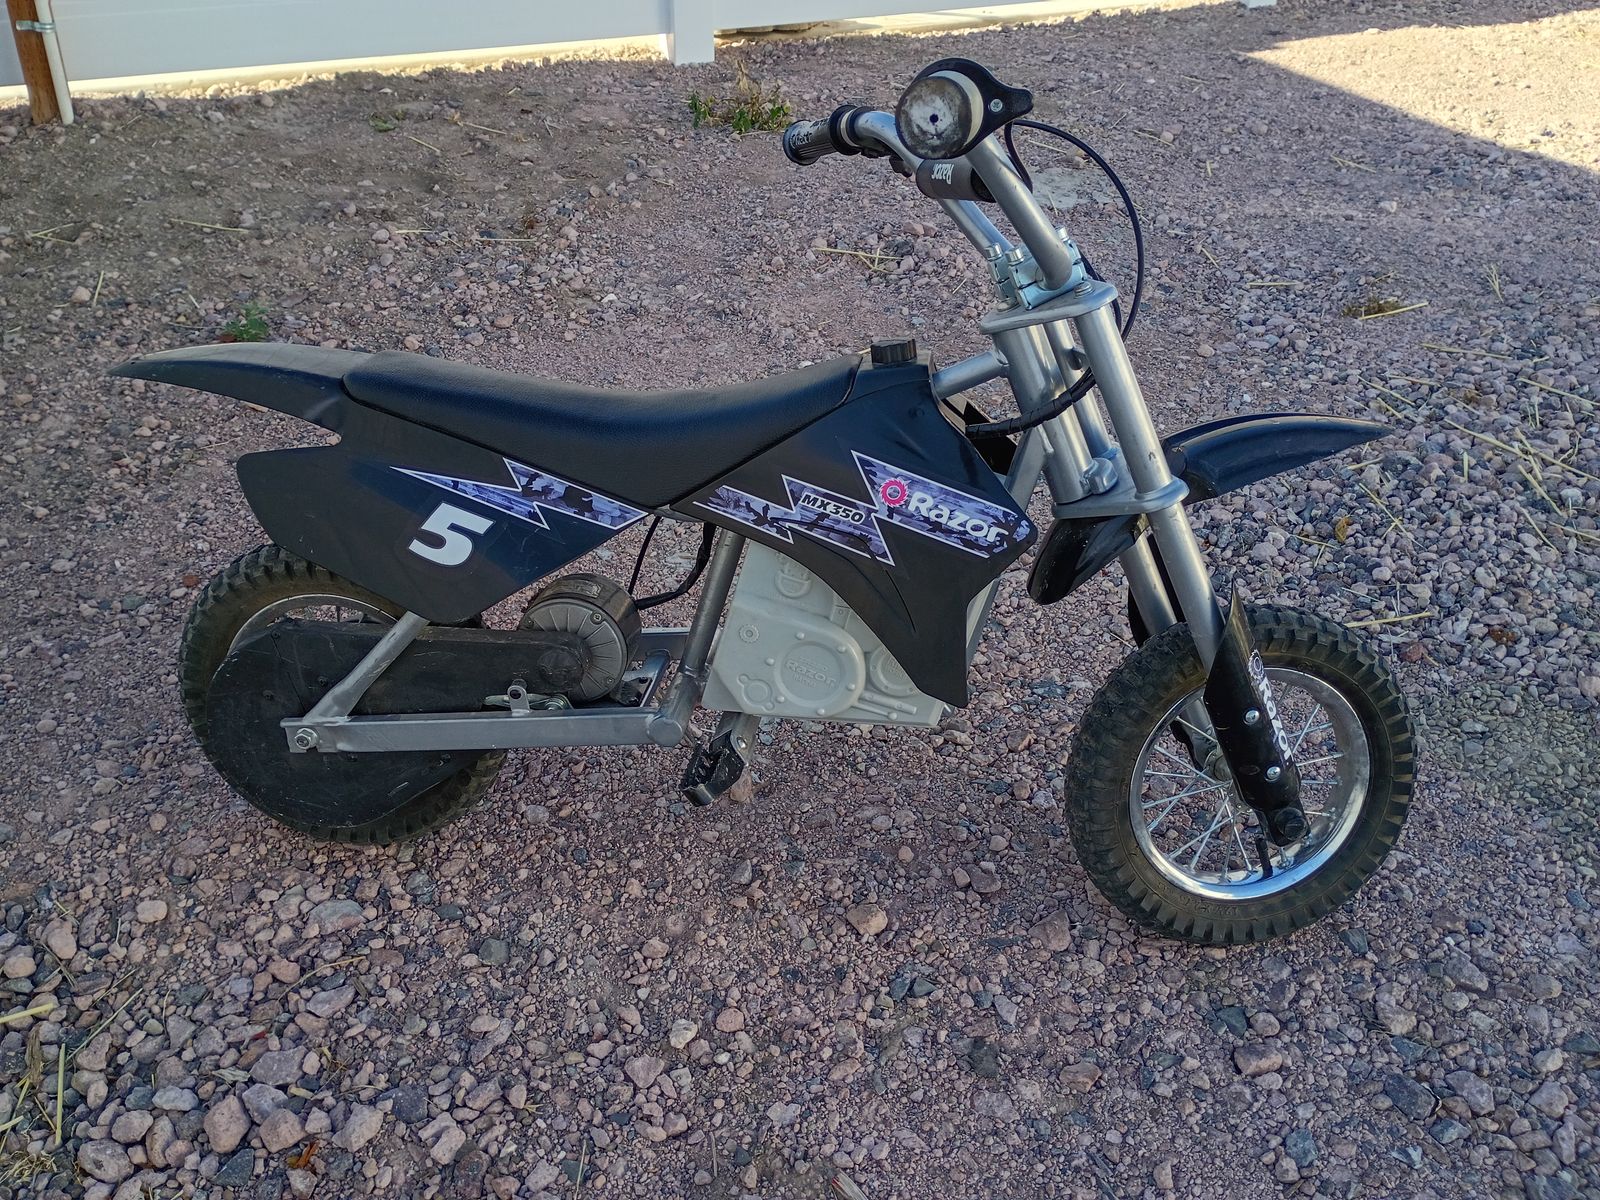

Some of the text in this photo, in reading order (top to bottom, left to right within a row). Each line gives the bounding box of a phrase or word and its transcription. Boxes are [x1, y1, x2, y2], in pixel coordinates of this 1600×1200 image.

[408, 502, 494, 566] 5
[801, 493, 865, 524] MX350
[907, 491, 1009, 543] Razor
[1258, 676, 1292, 760] Razor
